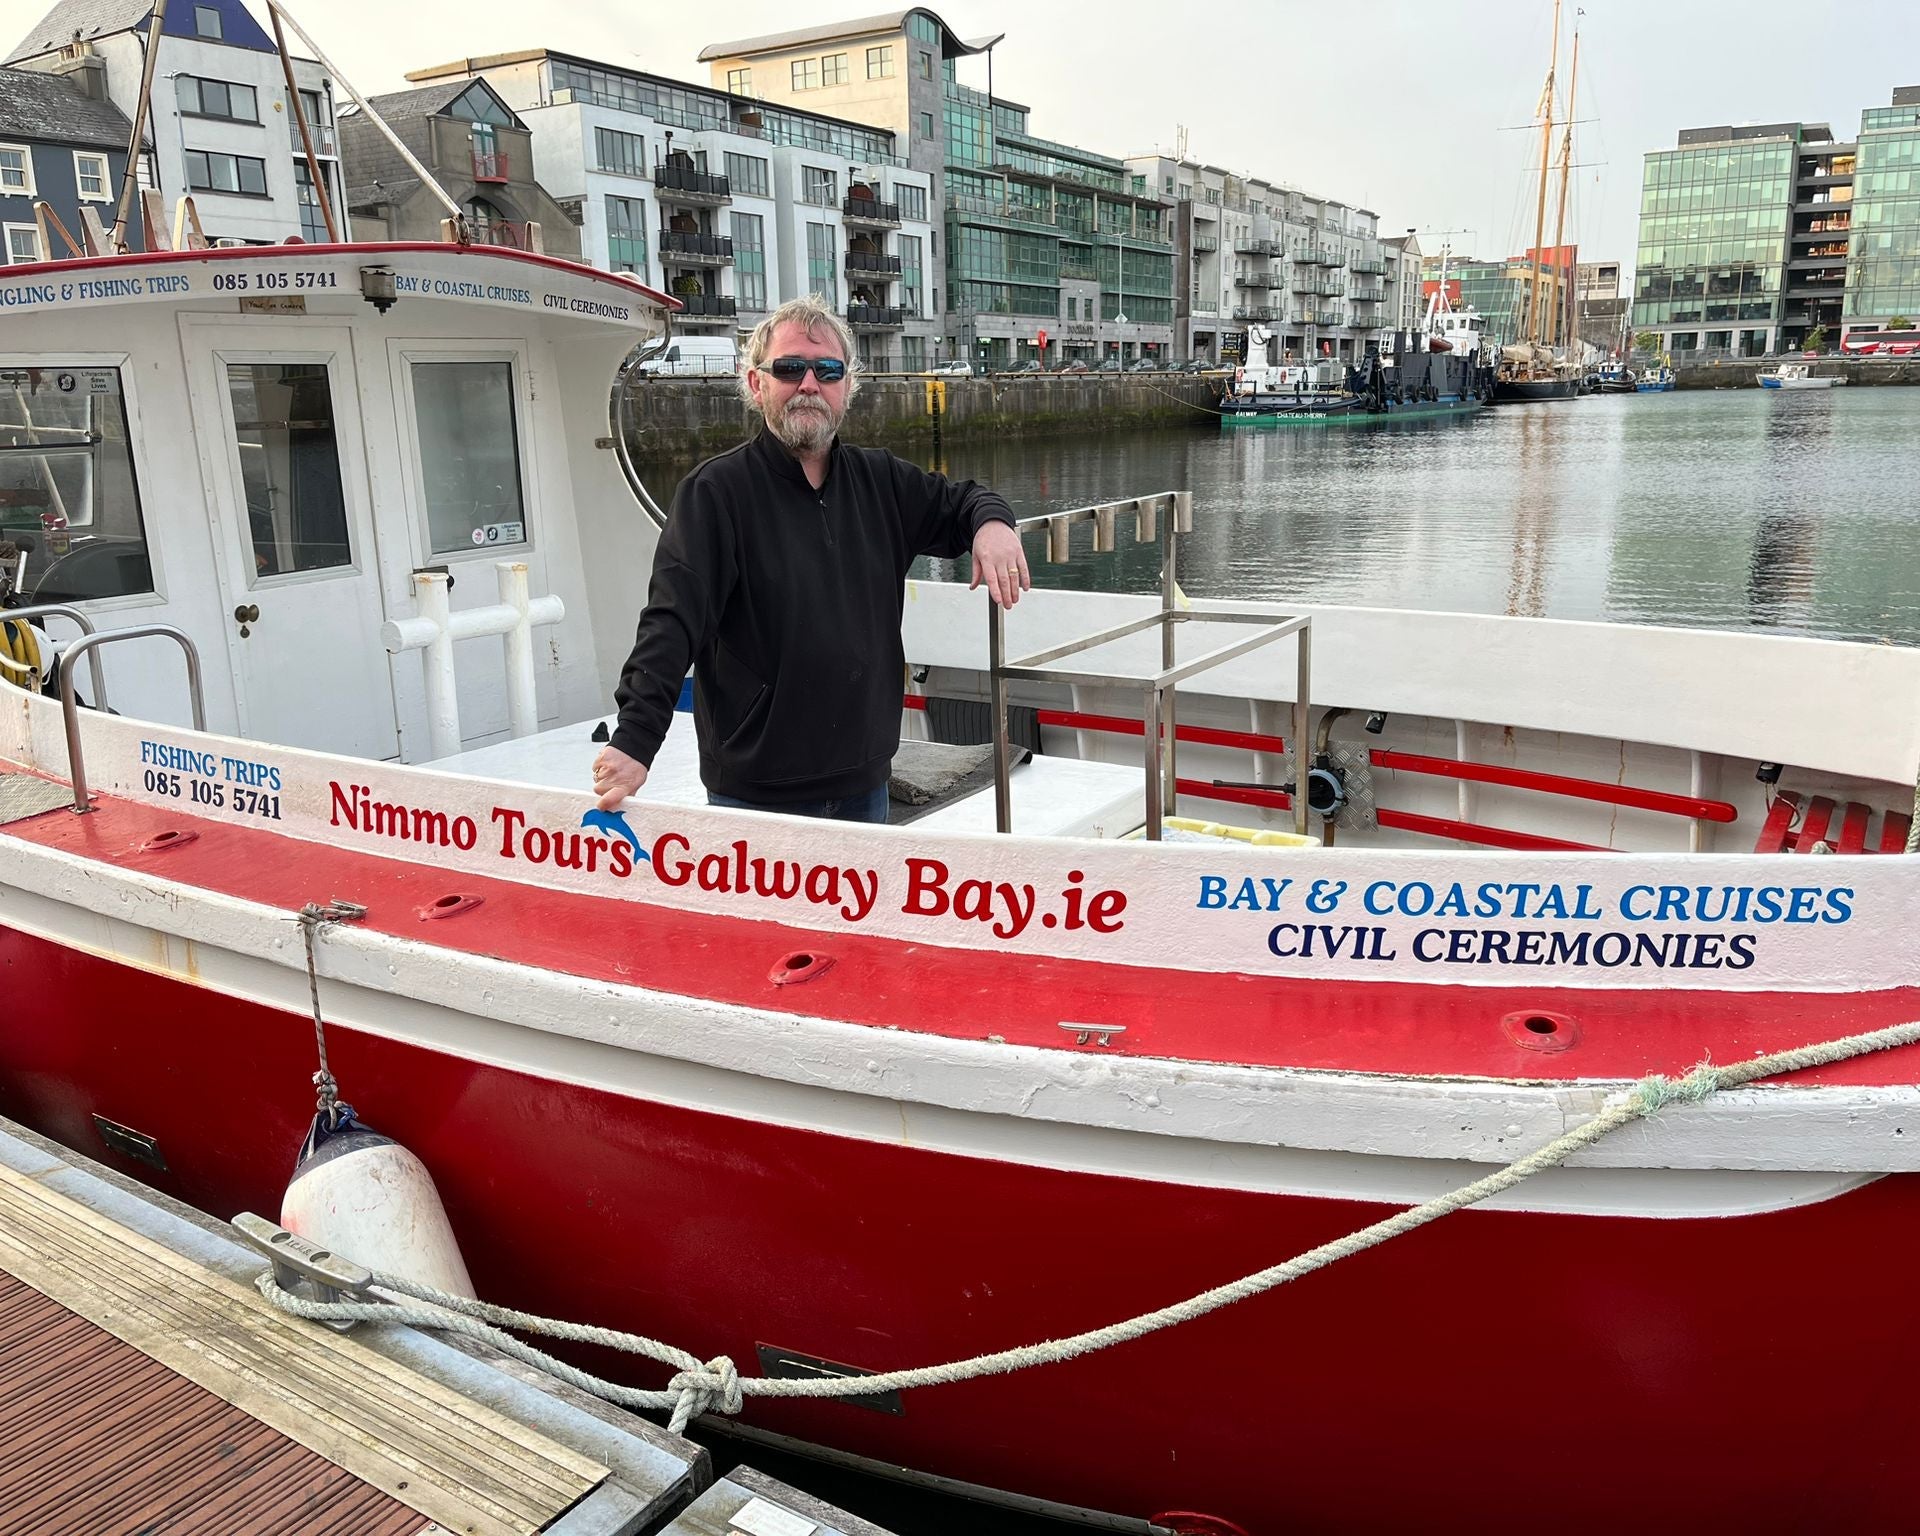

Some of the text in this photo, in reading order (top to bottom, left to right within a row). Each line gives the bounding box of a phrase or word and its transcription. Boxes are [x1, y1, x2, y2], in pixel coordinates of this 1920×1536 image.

[0, 275, 189, 306] GLING & FISHING TRIPS
[213, 272, 337, 291] 085 105 5741
[396, 275, 418, 292] BAY
[421, 279, 431, 293] &
[435, 281, 485, 298] COASTAL
[543, 293, 629, 321] CIVIL CEREMONIES
[140, 740, 282, 791] FISHING TRIPS
[144, 769, 282, 820] 085 105 5741
[329, 781, 1127, 939] Nimmo Tours Galway Bay.ie
[1197, 876, 1854, 924] BAY & COASTAL CRUISES
[1267, 923, 1757, 970] CIVIL CEREMONIES
